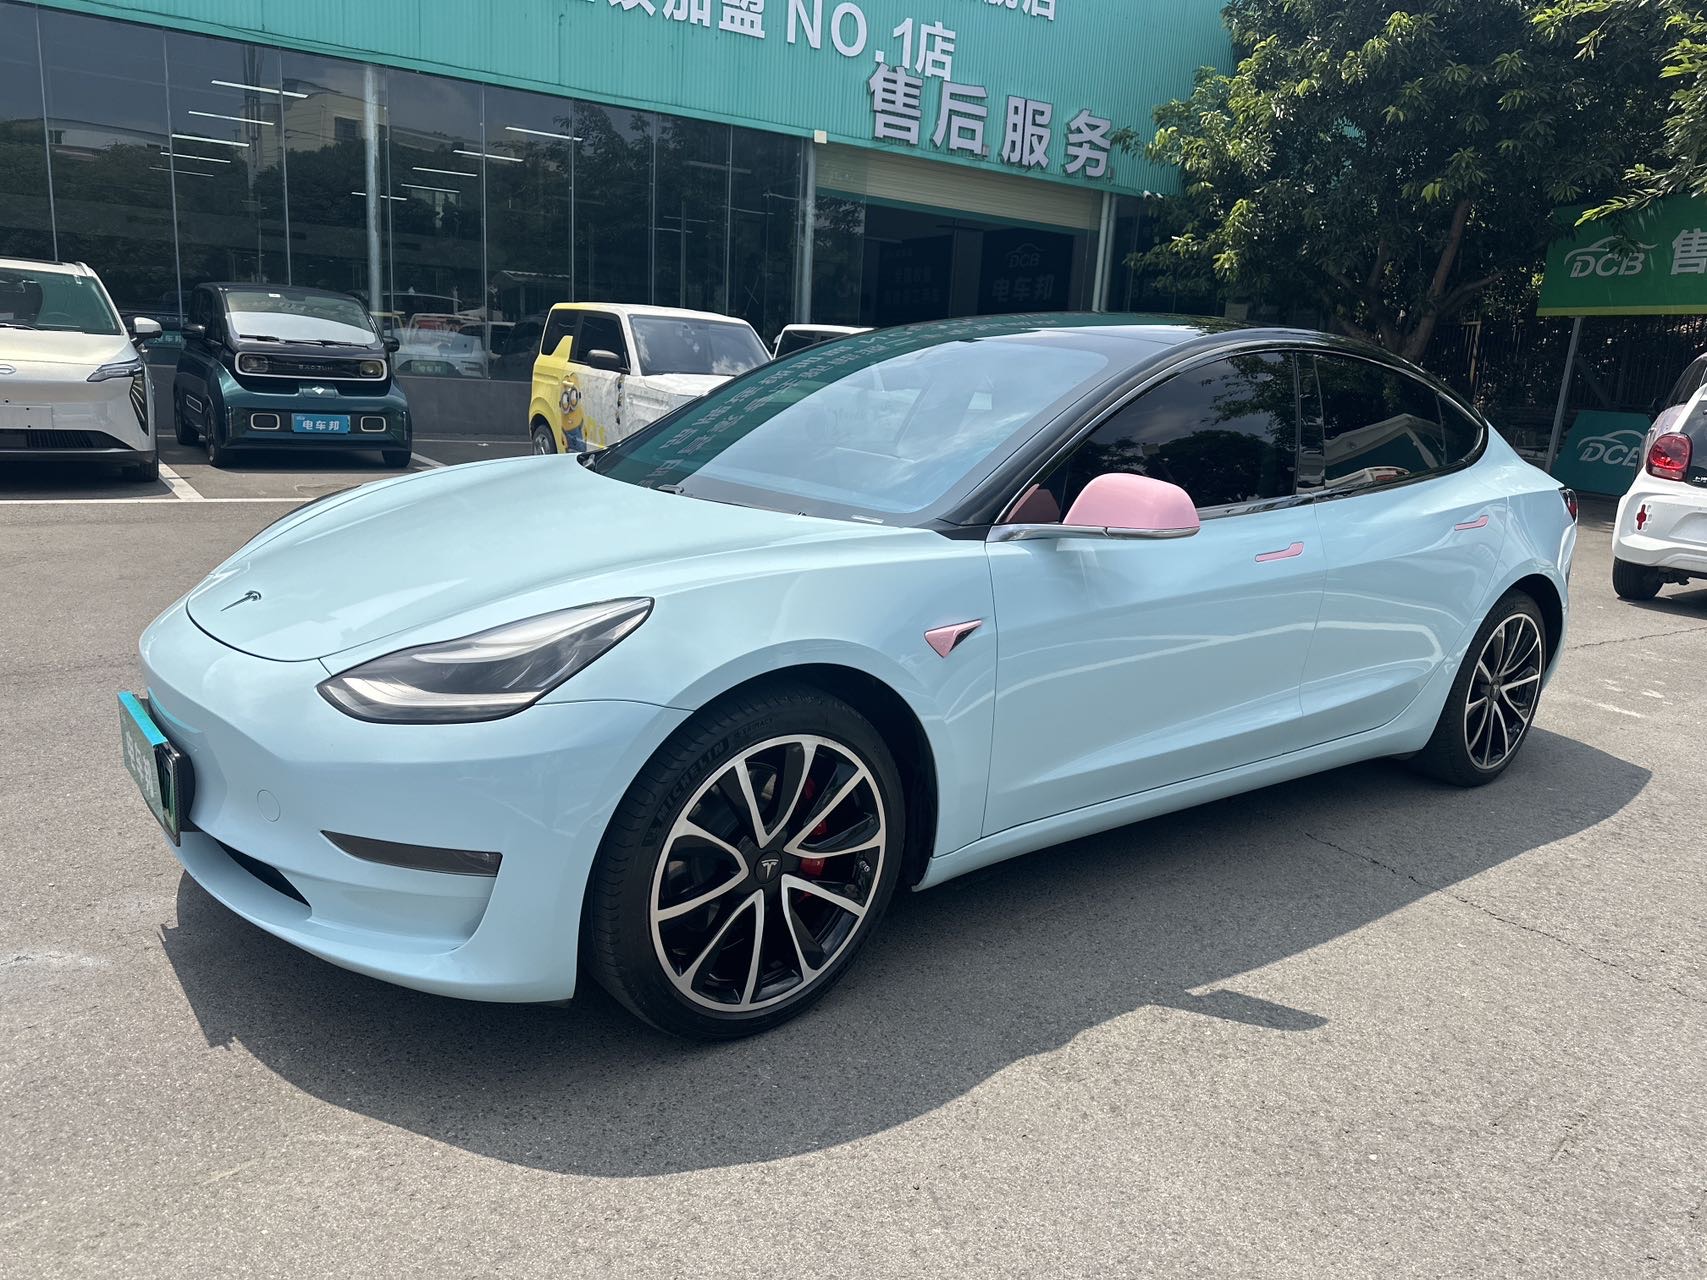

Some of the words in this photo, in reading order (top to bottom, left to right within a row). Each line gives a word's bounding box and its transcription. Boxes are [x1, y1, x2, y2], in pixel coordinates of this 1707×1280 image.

[868, 62, 1112, 178] 售后服务
[1569, 251, 1646, 278] DCB
[302, 420, 340, 431] 电车邦
